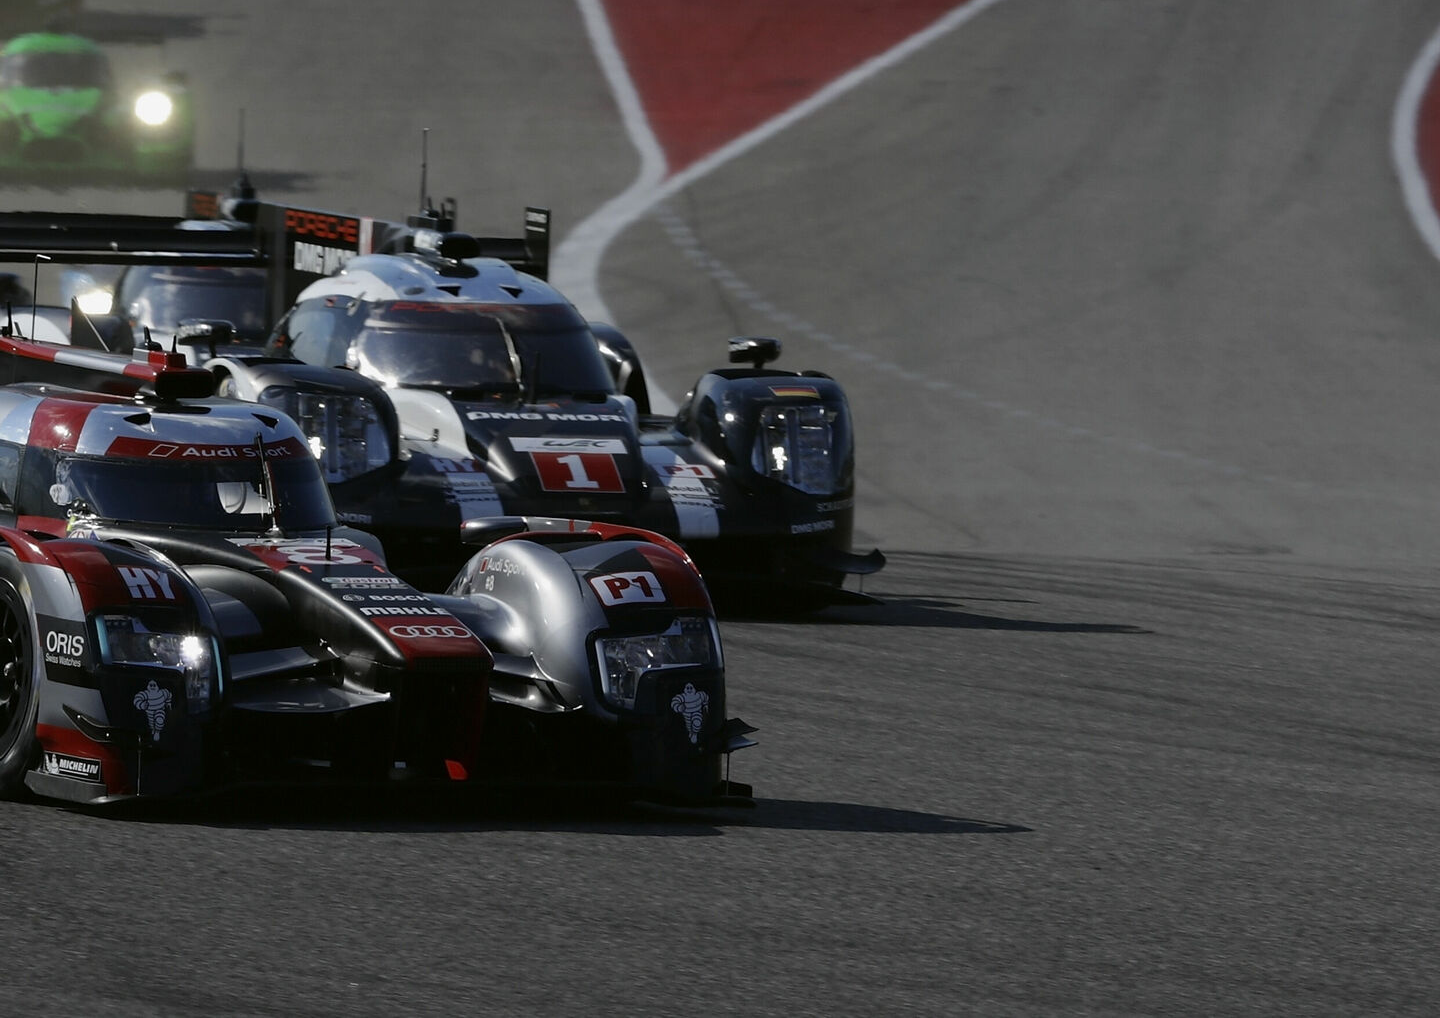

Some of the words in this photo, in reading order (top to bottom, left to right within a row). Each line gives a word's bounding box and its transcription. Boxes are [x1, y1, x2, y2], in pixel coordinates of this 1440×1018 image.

[466, 411, 540, 421] DMG
[182, 446, 239, 458] Audi
[543, 440, 612, 449] WEC
[557, 454, 600, 489] 1
[276, 545, 362, 565] 8
[117, 567, 175, 600] HY
[604, 576, 655, 600] P1
[359, 607, 453, 616] MAHLE
[46, 630, 85, 657] ORIS
[45, 652, 59, 664] Swiss
[59, 655, 82, 669] Watches
[59, 758, 100, 775] MICHELIN
